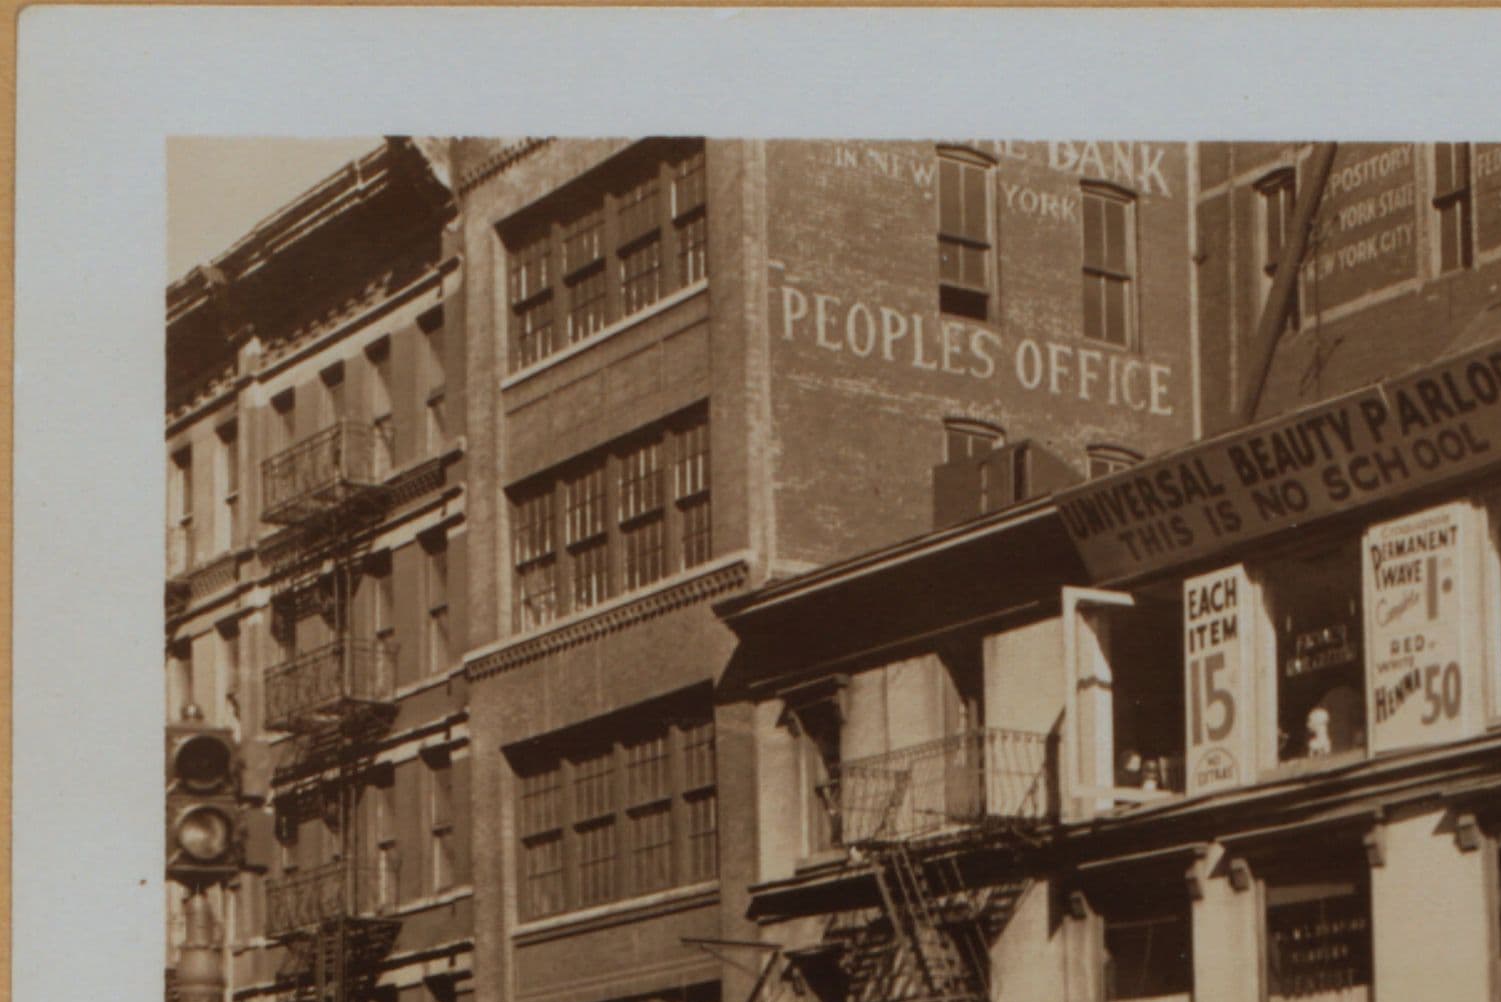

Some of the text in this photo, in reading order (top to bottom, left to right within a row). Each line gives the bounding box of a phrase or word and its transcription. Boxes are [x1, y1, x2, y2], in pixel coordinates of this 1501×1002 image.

[1329, 141, 1414, 199] POSITORY
[1002, 183, 1079, 223] YORK
[781, 287, 1174, 416] PEOPLES OFFICE
[1062, 455, 1225, 540] UNIVERSAL
[1227, 408, 1356, 486] BEAUTY
[1117, 422, 1491, 564] THIS IS NO SCHOOL
[1371, 524, 1458, 592] PERMANENT
[1381, 559, 1422, 591] WAVE
[1187, 577, 1238, 621] EACH
[1188, 614, 1238, 654] ITEM
[1390, 634, 1425, 655] RED
[1190, 652, 1235, 747] 15
[1421, 661, 1462, 727] 50
